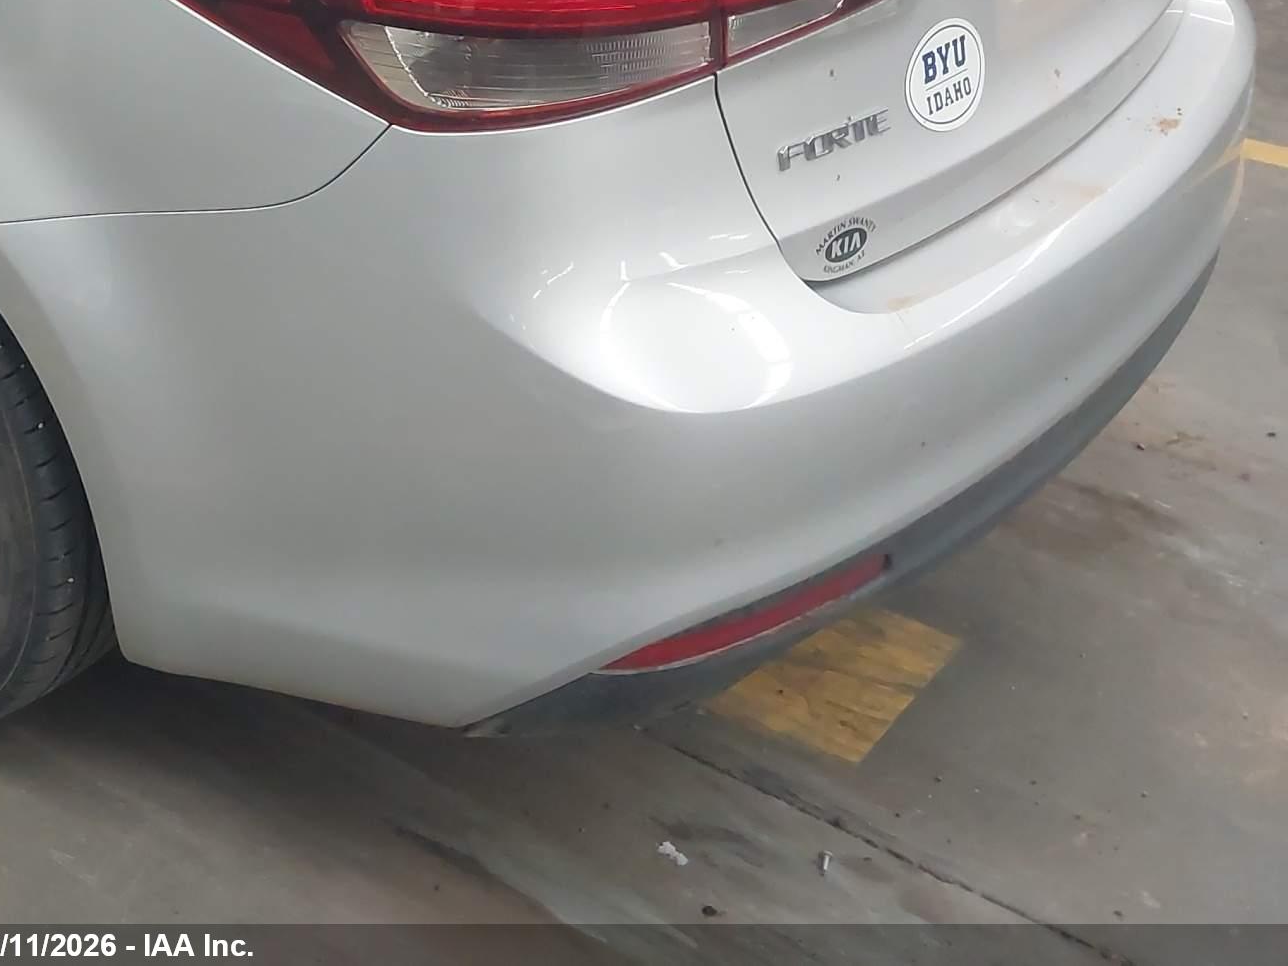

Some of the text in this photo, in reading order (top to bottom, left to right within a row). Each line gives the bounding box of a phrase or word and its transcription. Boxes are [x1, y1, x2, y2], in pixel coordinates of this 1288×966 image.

[922, 34, 966, 85] BYU
[926, 76, 972, 116] IDAHO
[776, 107, 891, 172] FORTE
[831, 231, 862, 260] KIA
